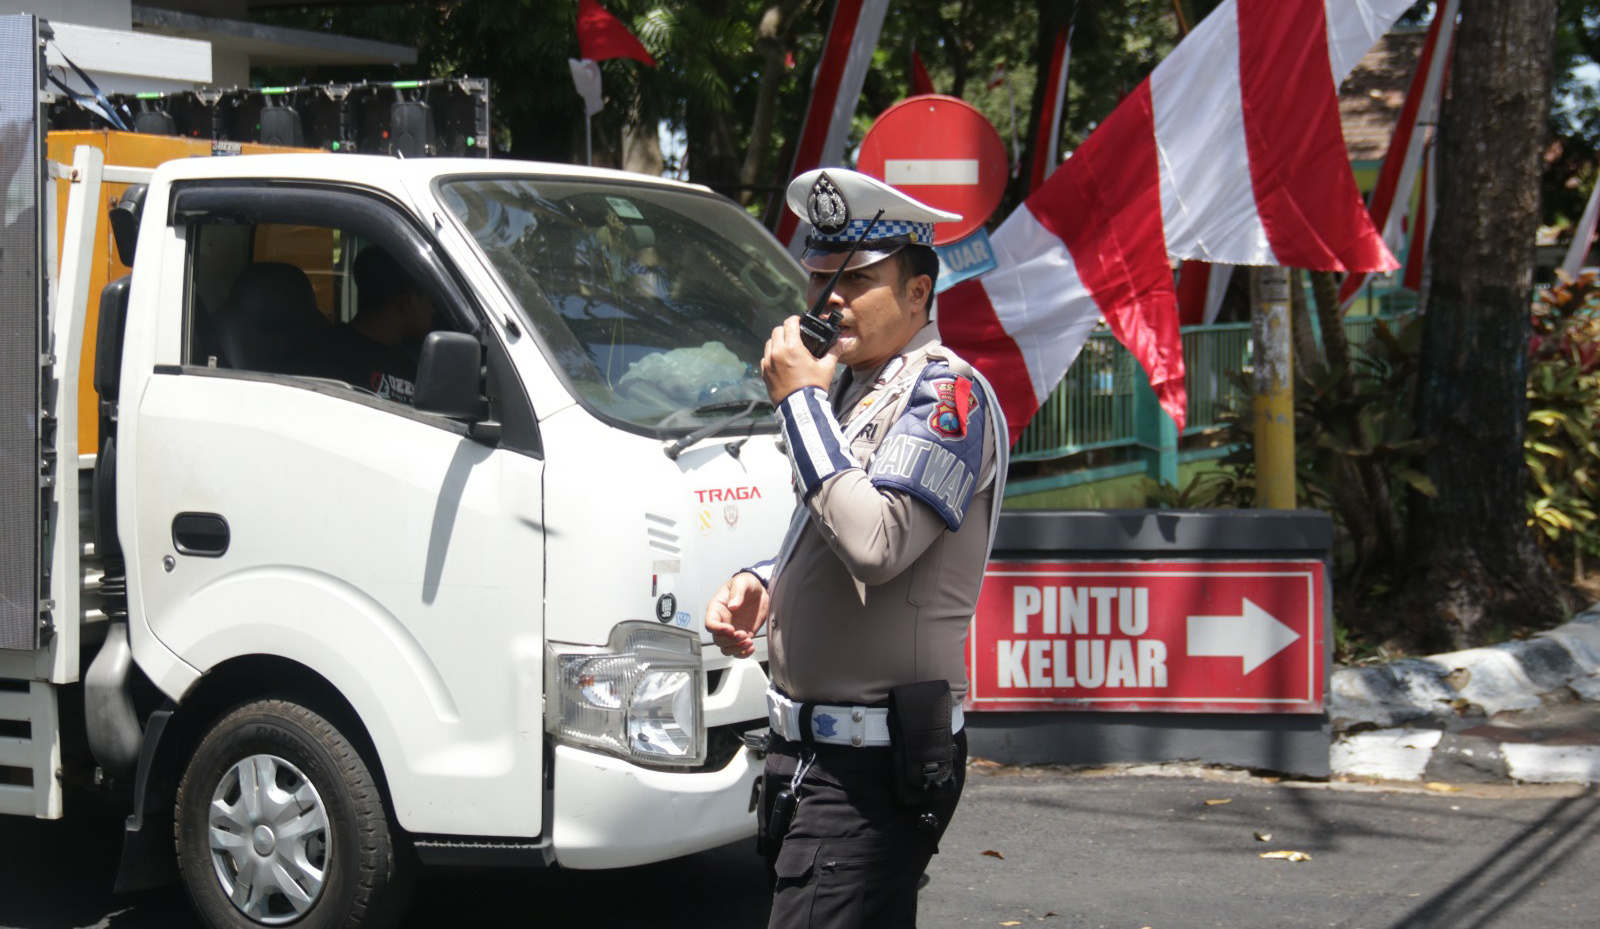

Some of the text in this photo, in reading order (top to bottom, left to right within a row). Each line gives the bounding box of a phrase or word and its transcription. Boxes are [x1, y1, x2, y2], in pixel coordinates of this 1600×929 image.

[694, 486, 762, 503] TRAGA
[1013, 585, 1149, 636] PINTU
[997, 639, 1168, 689] KELUAR
